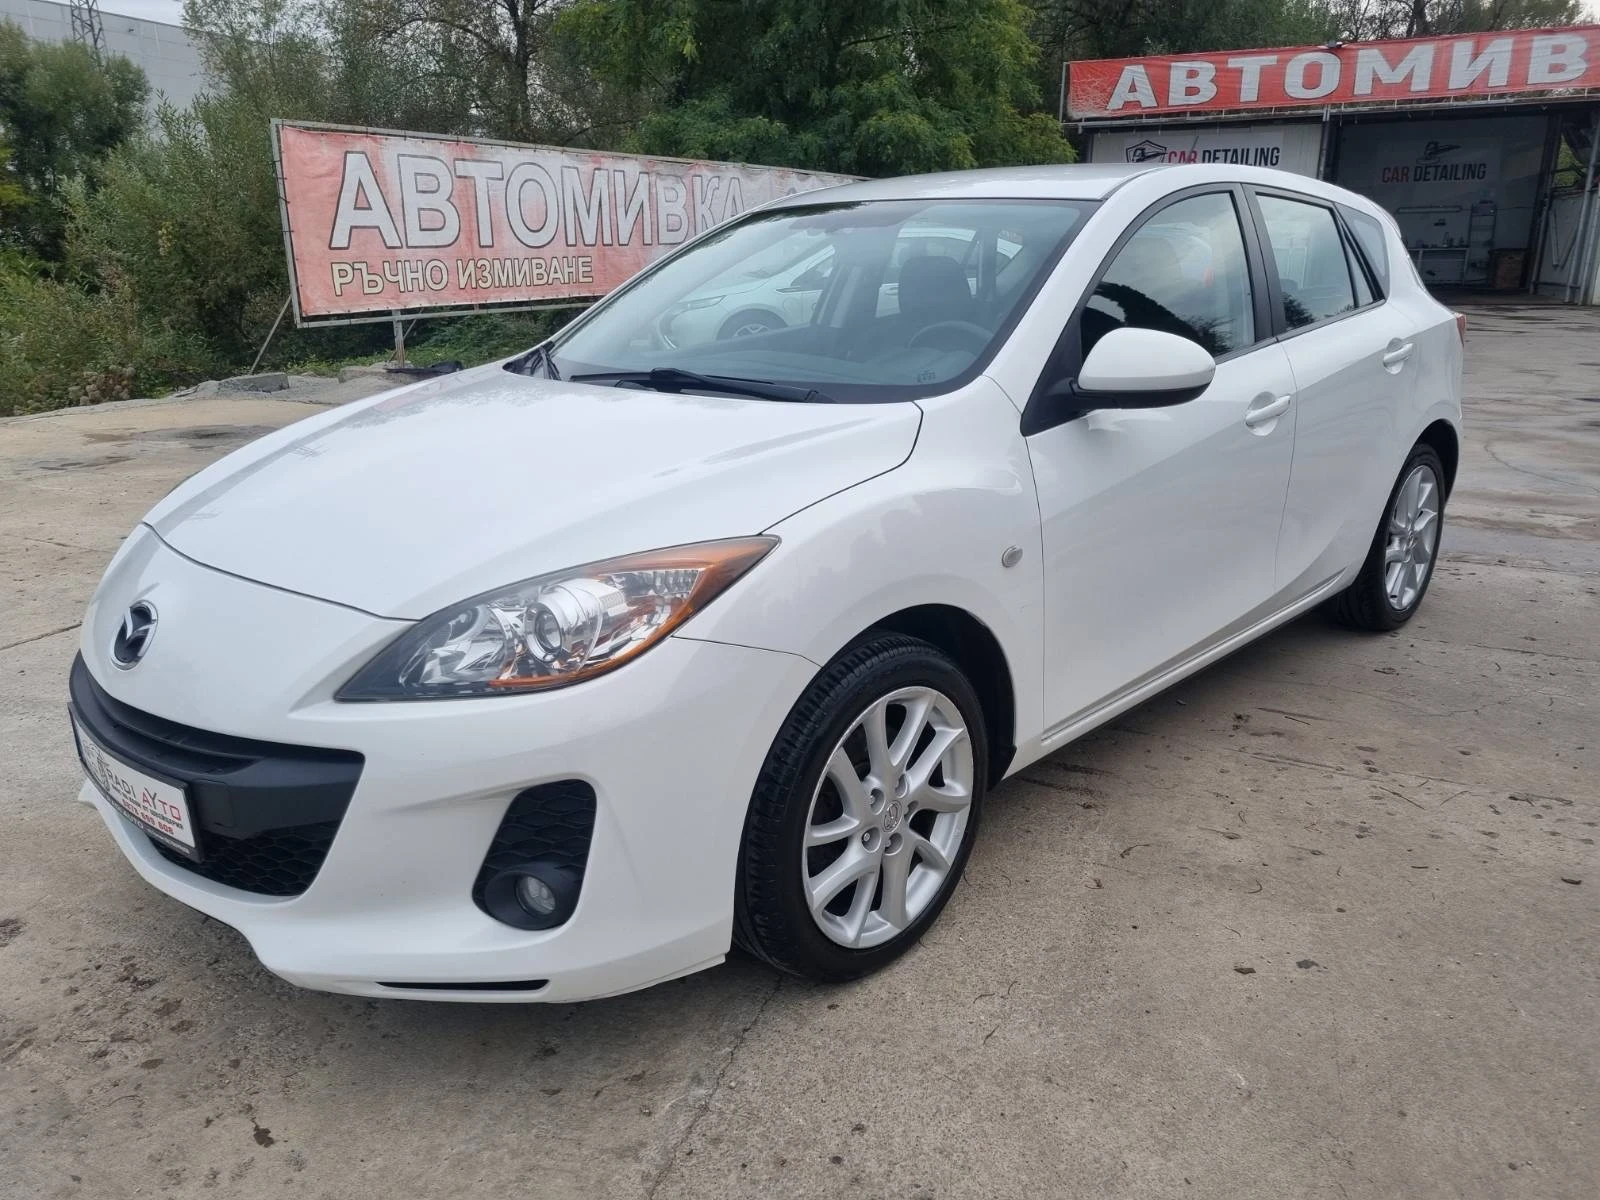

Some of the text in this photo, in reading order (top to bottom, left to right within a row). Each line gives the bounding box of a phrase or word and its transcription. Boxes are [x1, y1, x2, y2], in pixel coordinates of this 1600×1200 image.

[1107, 34, 1589, 111] АВТОМИВ
[1202, 147, 1281, 166] DETAILING
[1382, 163, 1487, 183] CAR DETAILING
[330, 256, 593, 297] РЪЧНО ИЗМИВАНЕ
